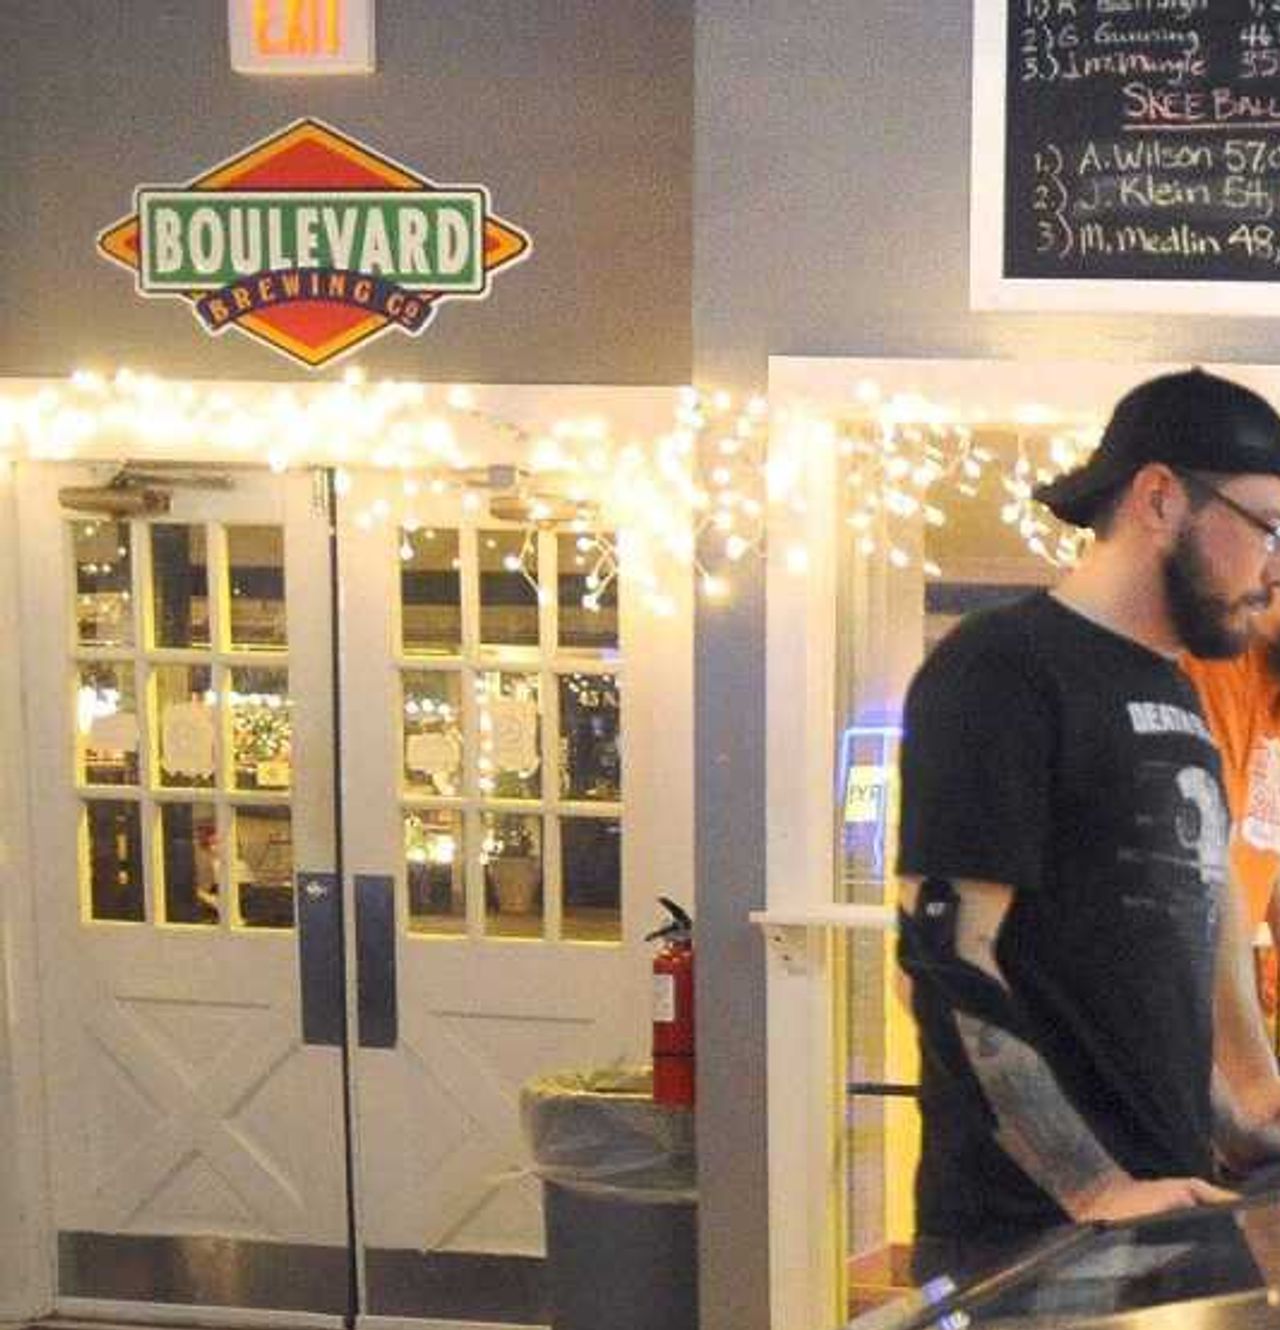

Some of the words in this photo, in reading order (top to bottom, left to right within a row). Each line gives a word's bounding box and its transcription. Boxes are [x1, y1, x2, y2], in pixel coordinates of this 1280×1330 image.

[1119, 175, 1211, 207] Klein
[154, 203, 474, 276] BOULEVARD
[207, 270, 374, 325] BREWING
